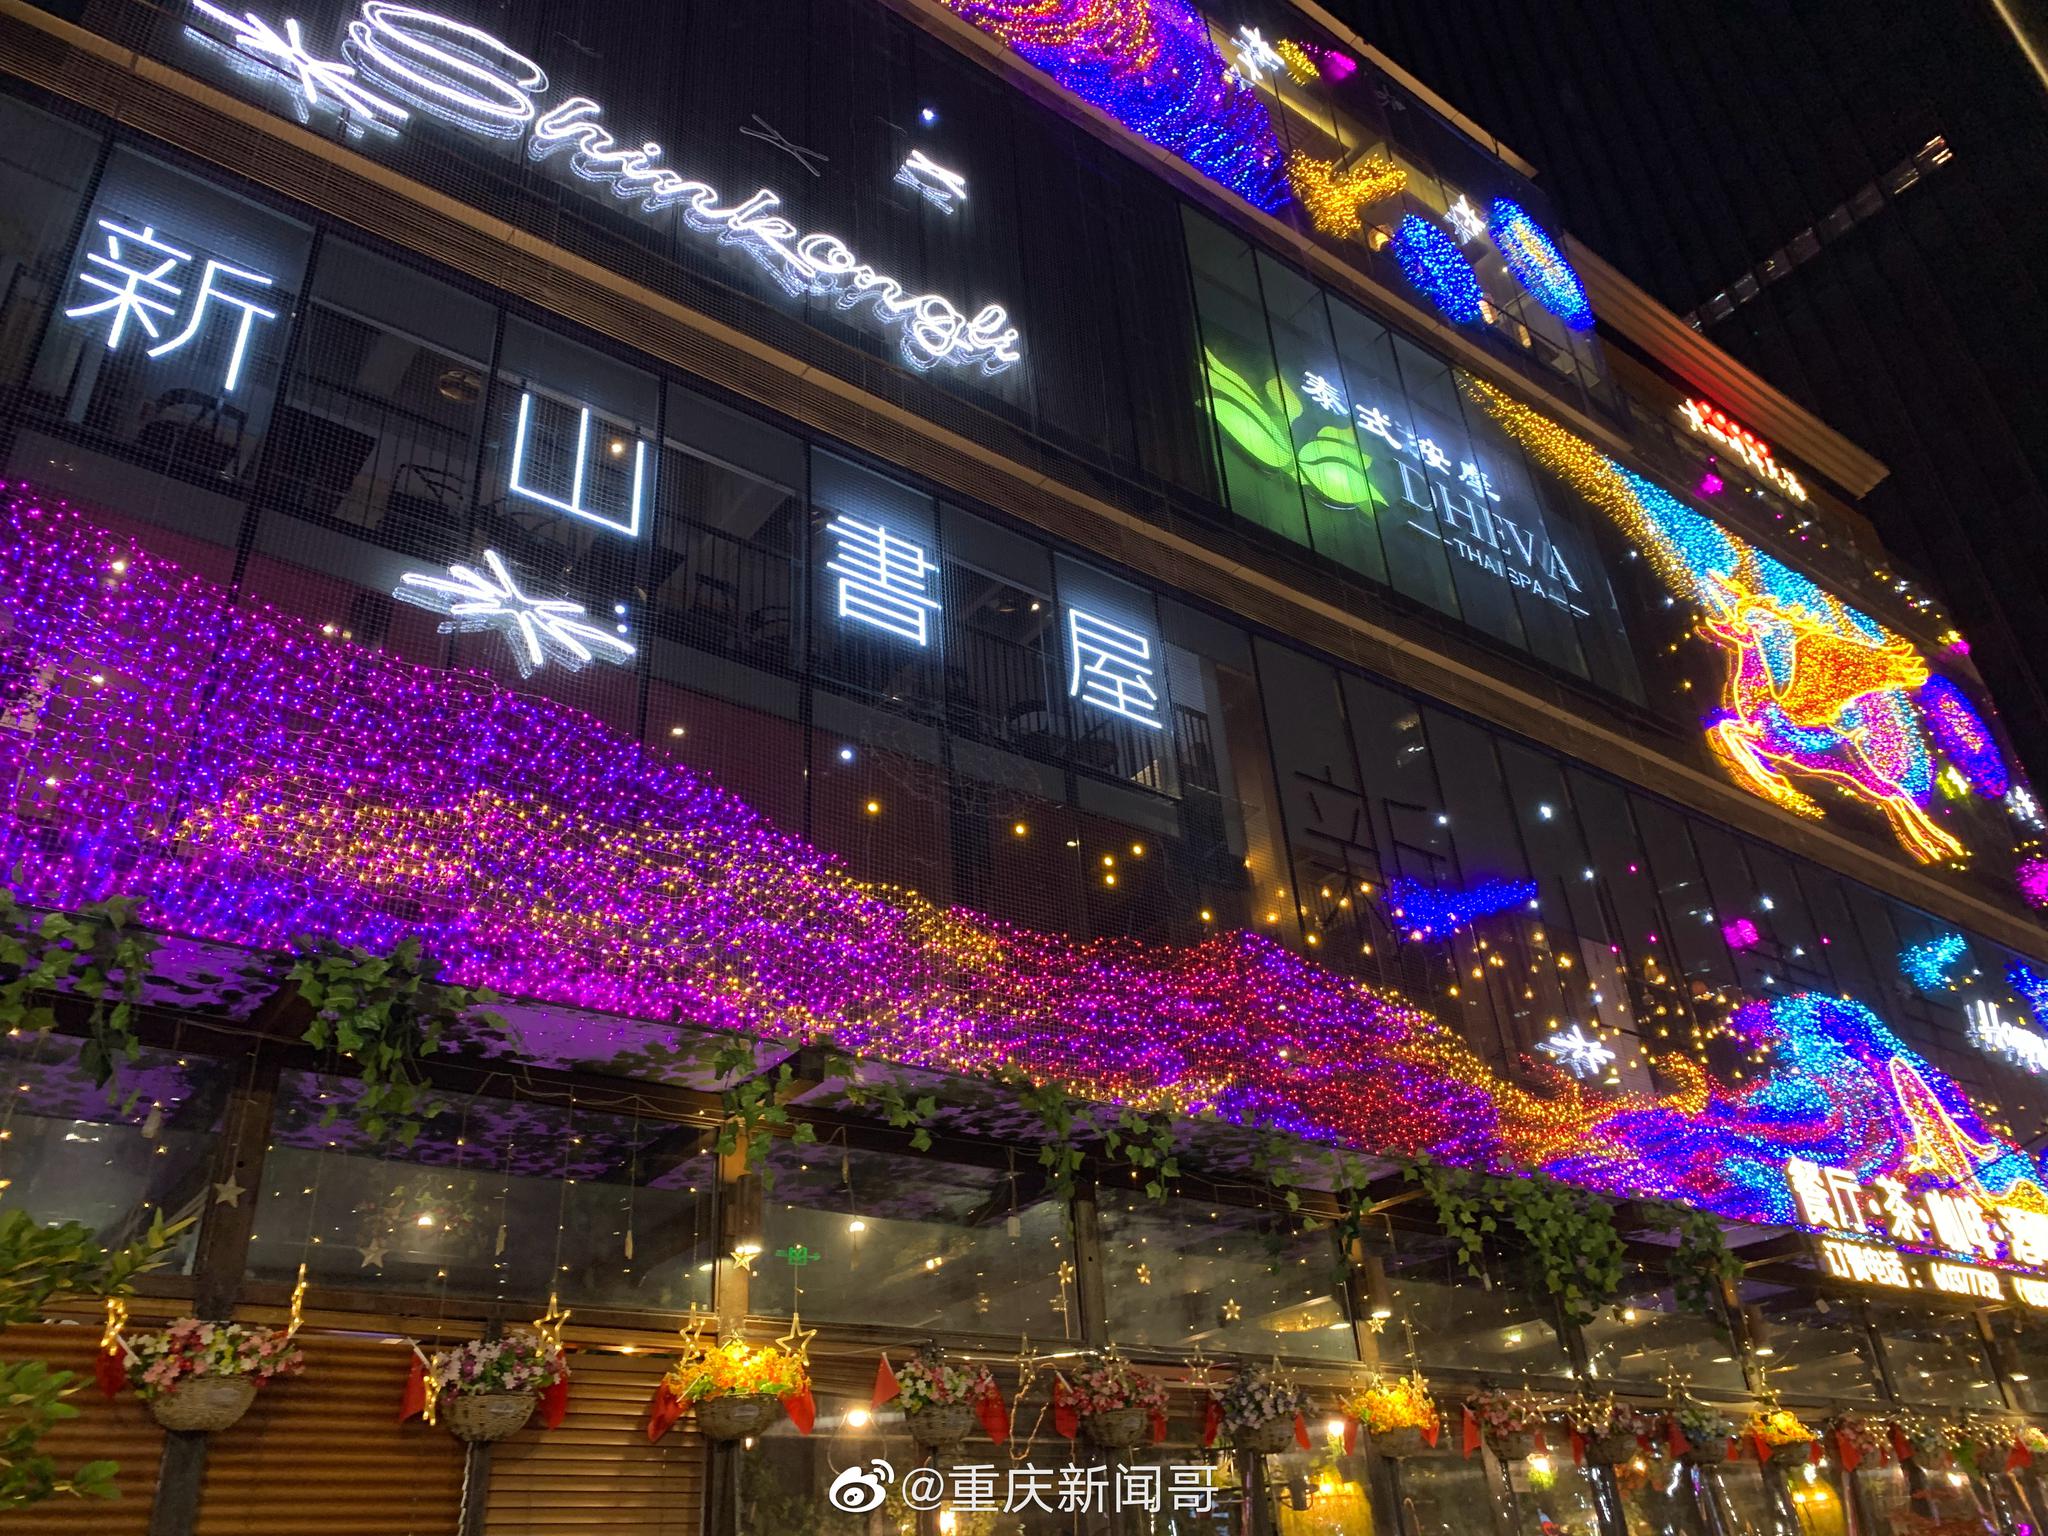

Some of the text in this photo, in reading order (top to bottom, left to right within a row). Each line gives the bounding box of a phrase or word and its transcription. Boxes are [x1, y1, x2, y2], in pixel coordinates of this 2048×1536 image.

[1300, 370, 1502, 502] 泰式按摩
[1393, 457, 1583, 593] DHEVA
[1453, 538, 1548, 599] THAI SPA
